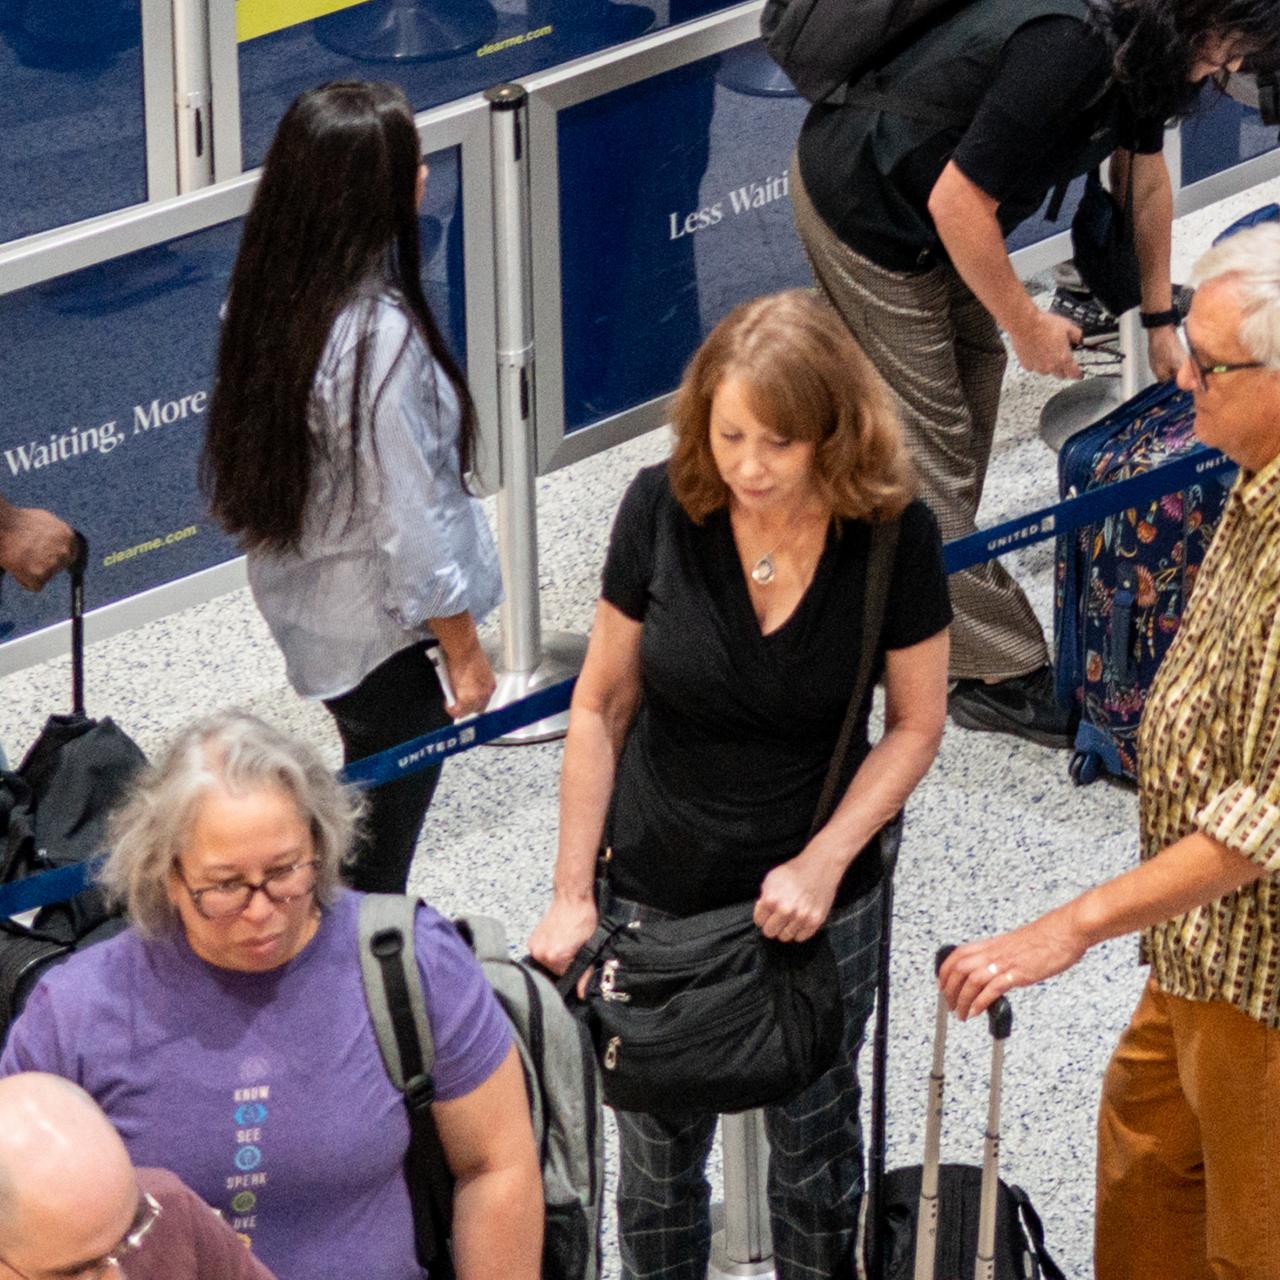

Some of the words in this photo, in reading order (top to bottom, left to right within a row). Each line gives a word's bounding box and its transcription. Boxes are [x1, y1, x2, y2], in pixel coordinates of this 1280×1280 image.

[477, 25, 552, 57] clearme.com
[669, 203, 722, 241] Less
[729, 170, 789, 214] Waiti
[3, 421, 124, 476] Waiting,
[133, 390, 207, 435] More
[1196, 452, 1230, 473] UNIT
[103, 524, 198, 567] clearme.com
[987, 524, 1038, 552] UNITED
[398, 736, 457, 768] UNITED
[234, 1085, 270, 1102] KNOW
[236, 1127, 261, 1143] SEE
[226, 1172, 267, 1190] SPEAK
[233, 1216, 257, 1230] OVE
